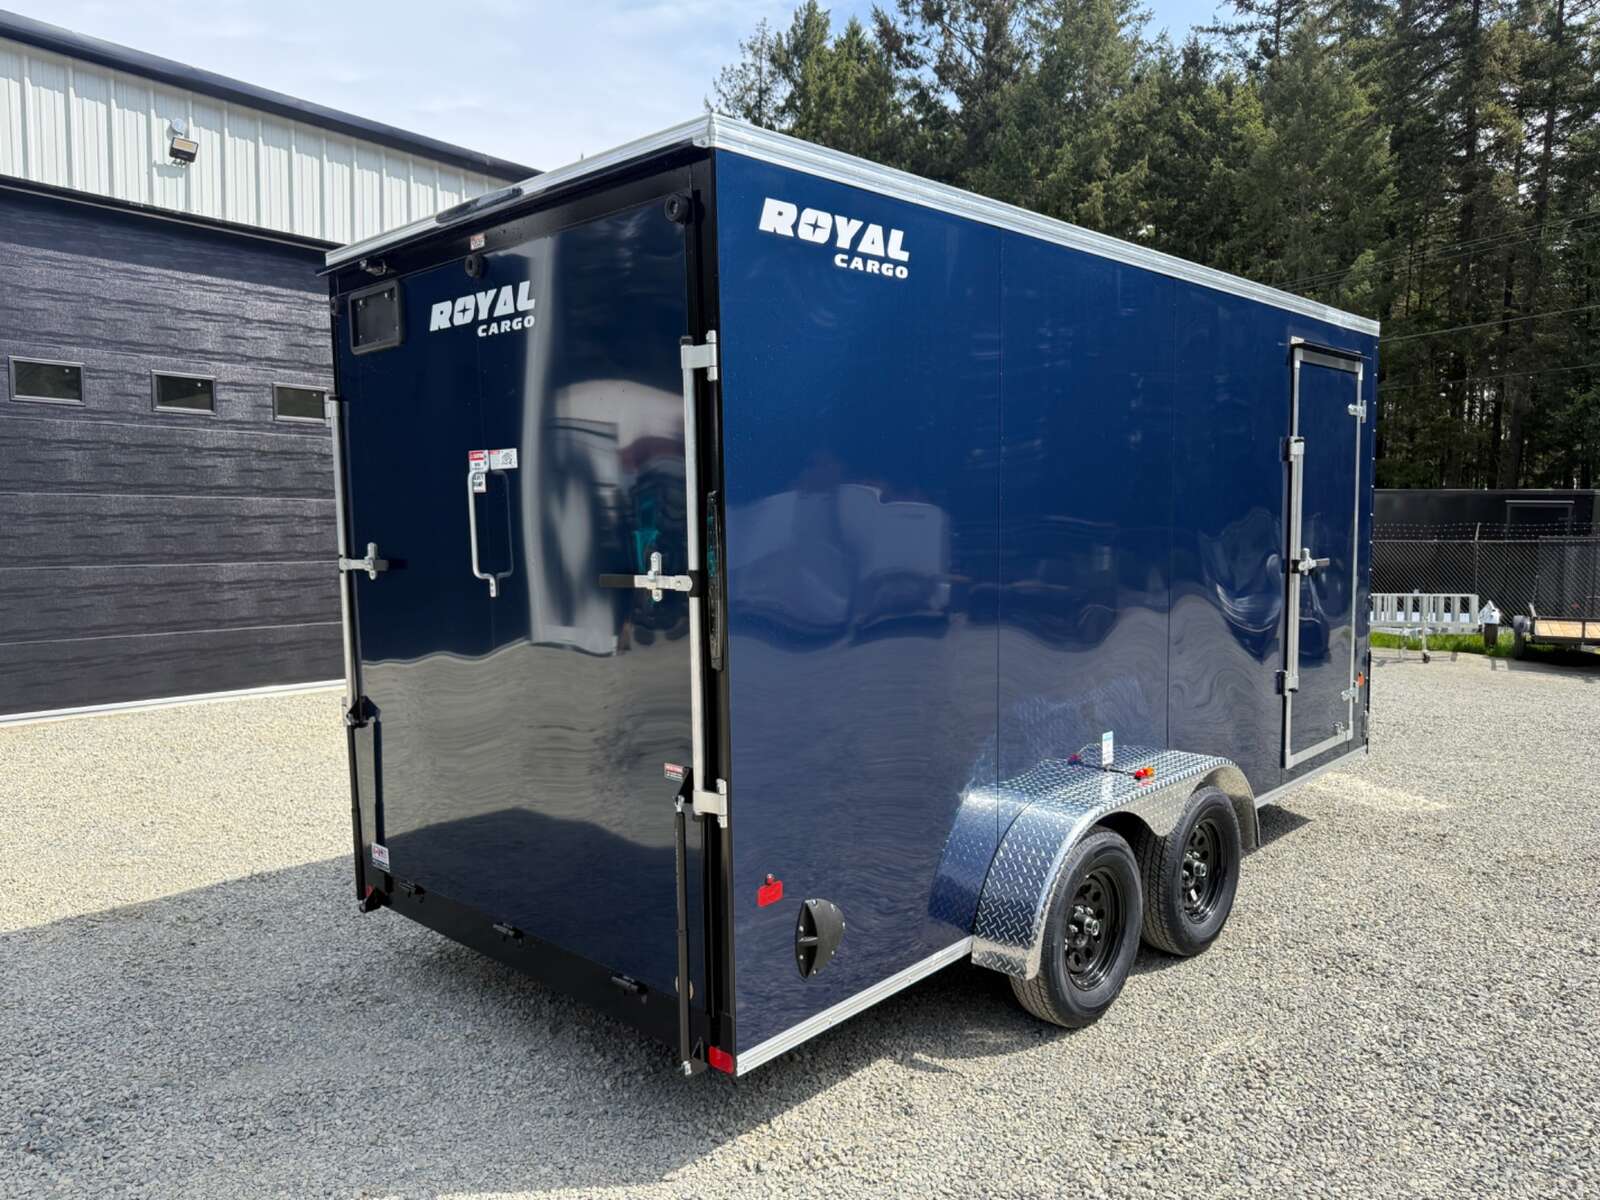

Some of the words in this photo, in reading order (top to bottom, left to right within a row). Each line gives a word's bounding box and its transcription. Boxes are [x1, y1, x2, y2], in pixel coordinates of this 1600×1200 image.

[759, 197, 910, 262] ROYAL
[834, 253, 909, 279] CARGO
[429, 280, 536, 332] ROYAL
[477, 315, 535, 337] CARGO
